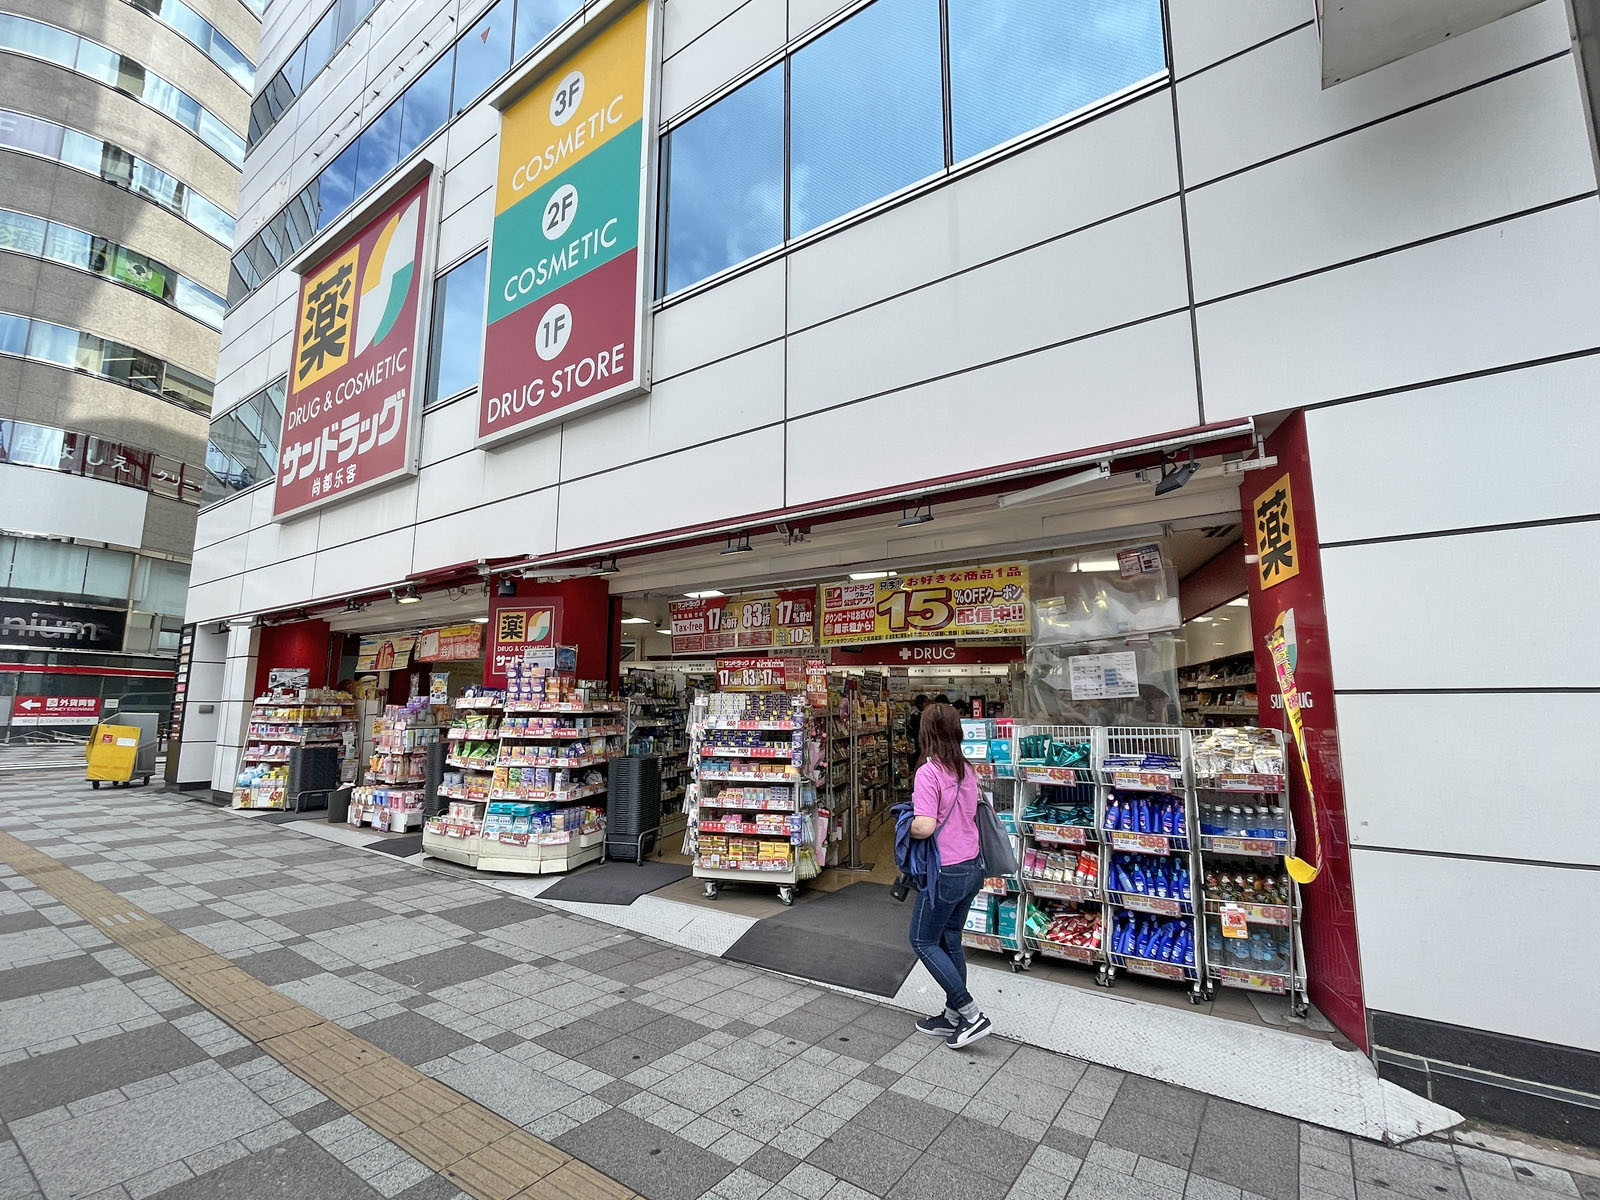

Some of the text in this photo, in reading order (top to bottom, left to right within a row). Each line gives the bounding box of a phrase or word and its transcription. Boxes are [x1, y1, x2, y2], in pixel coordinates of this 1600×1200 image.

[554, 77, 580, 118] 3F
[512, 95, 624, 191] COSMETIC
[546, 192, 574, 231] 2F
[504, 217, 618, 301] COSMETIC
[298, 262, 353, 383] 薬
[543, 313, 566, 348] 1F
[288, 347, 408, 431] DRUG & COSMETIC
[487, 342, 625, 424] DRUG STORE
[282, 388, 406, 487] サンドラッグ
[312, 463, 357, 498] 尚都乐客
[1257, 488, 1293, 581] 薬
[907, 566, 1022, 587] お好きな商品1品
[706, 608, 721, 631] 17
[743, 603, 762, 627] 83
[776, 601, 793, 624] 17
[877, 587, 954, 632] 15
[956, 604, 1025, 626] 配信中!!
[501, 615, 524, 640] 薬
[674, 621, 703, 633] Tax-free
[789, 628, 804, 643] 10
[914, 647, 957, 660] DRUG
[719, 670, 729, 686] 17
[743, 669, 756, 686] 83
[762, 669, 773, 685] 17
[1048, 768, 1072, 780] 438
[1140, 773, 1167, 785] 548
[1247, 775, 1274, 785] 258
[1138, 836, 1165, 848] 398
